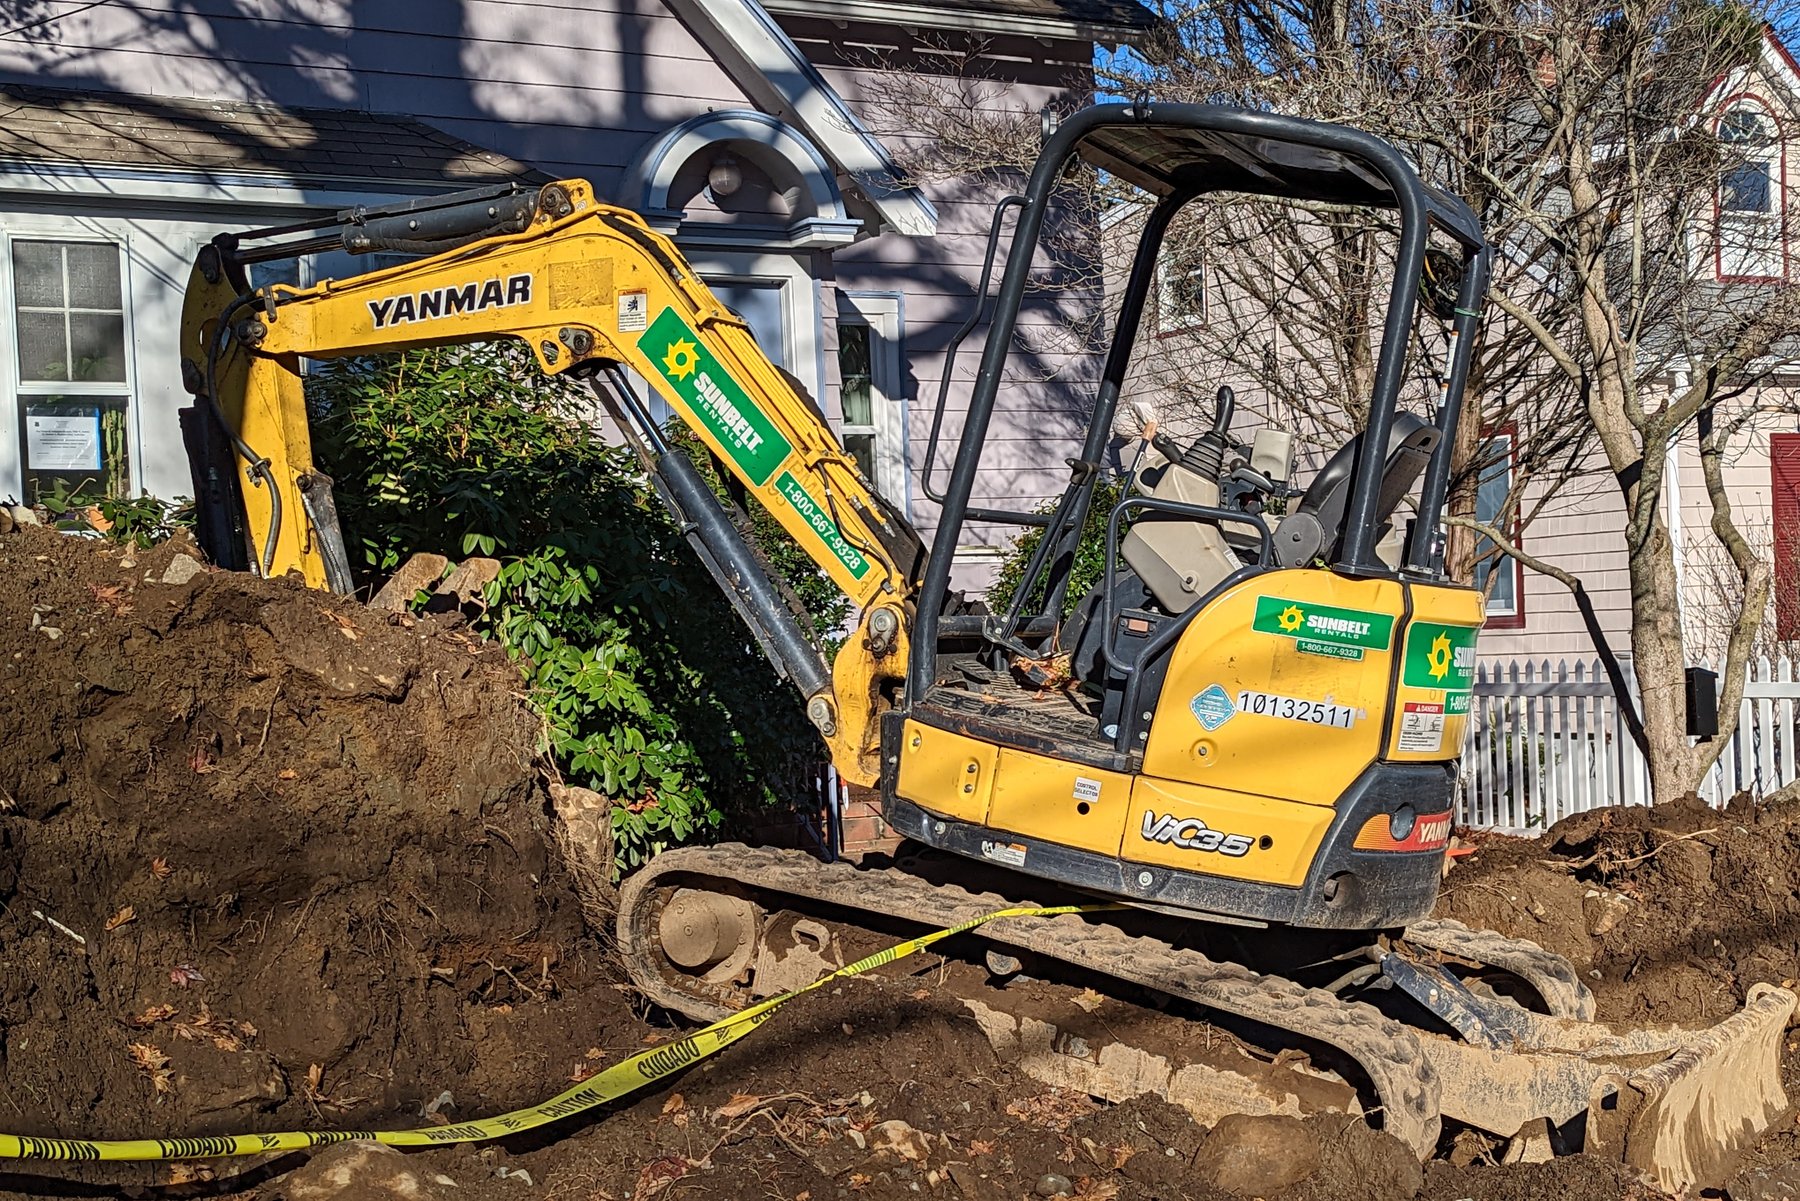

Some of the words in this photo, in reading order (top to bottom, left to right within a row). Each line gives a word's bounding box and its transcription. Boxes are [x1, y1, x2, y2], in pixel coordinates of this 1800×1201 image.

[368, 274, 532, 328] YANMAR
[693, 371, 764, 452] SUNBELT
[696, 394, 743, 449] RENTALS
[784, 482, 861, 570] 1-800-667-9328
[1306, 614, 1371, 635] SUNBELT
[1314, 628, 1360, 639] RENTALS
[1301, 642, 1358, 658] 1-800-667-9328
[1240, 692, 1352, 728] 10132511
[1074, 787, 1098, 797] SELECTOR
[1076, 782, 1098, 791] CONTROL
[537, 1087, 607, 1118] CAUTION
[637, 1038, 701, 1079] CUIDADO
